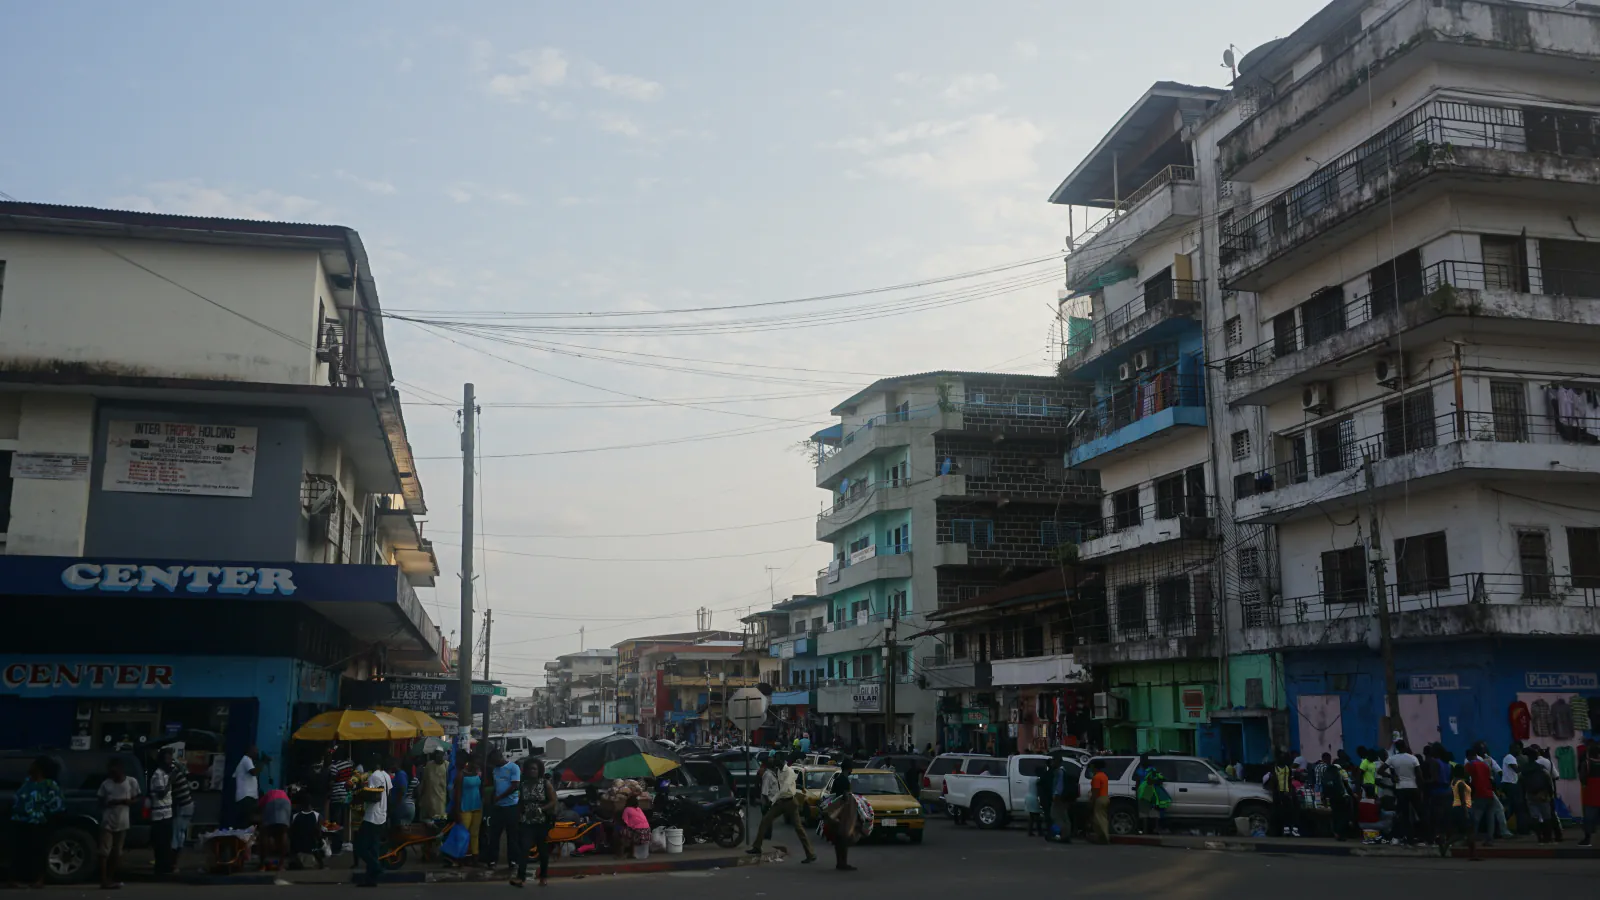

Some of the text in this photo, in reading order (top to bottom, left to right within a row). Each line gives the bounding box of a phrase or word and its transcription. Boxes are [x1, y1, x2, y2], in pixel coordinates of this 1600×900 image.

[135, 423, 236, 439] INTER TROPIC HOLDING
[61, 563, 297, 596] CENTER
[2, 663, 174, 690] CENTER
[1529, 674, 1557, 686] Pink
[1569, 675, 1595, 686] Blue
[434, 683, 447, 692] FOR
[860, 686, 879, 695] GILAR
